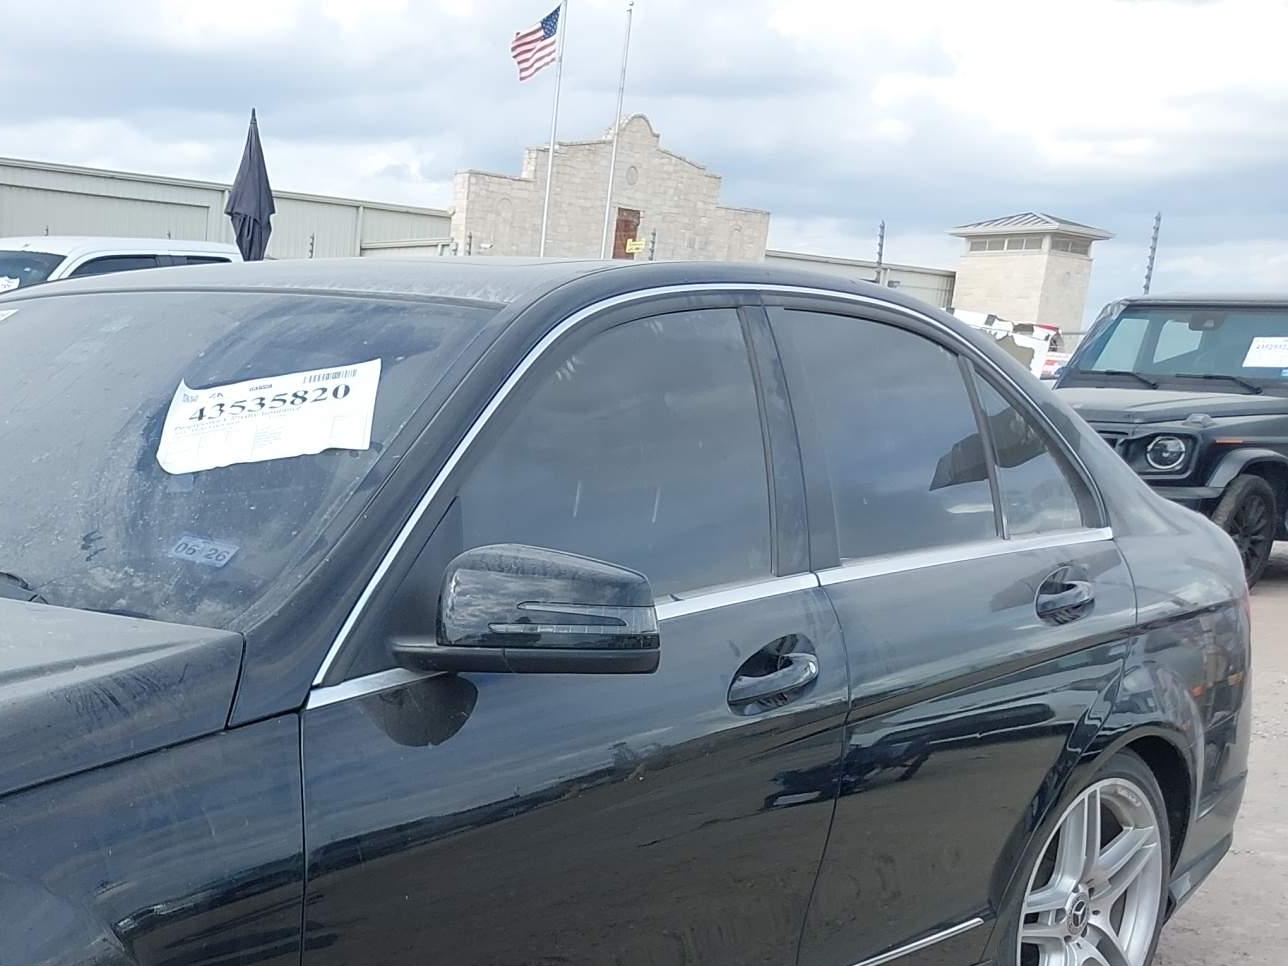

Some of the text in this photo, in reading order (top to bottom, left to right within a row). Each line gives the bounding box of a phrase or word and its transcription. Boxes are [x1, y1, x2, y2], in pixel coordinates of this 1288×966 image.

[189, 384, 351, 422] 43535820
[174, 542, 230, 562] 06 26
